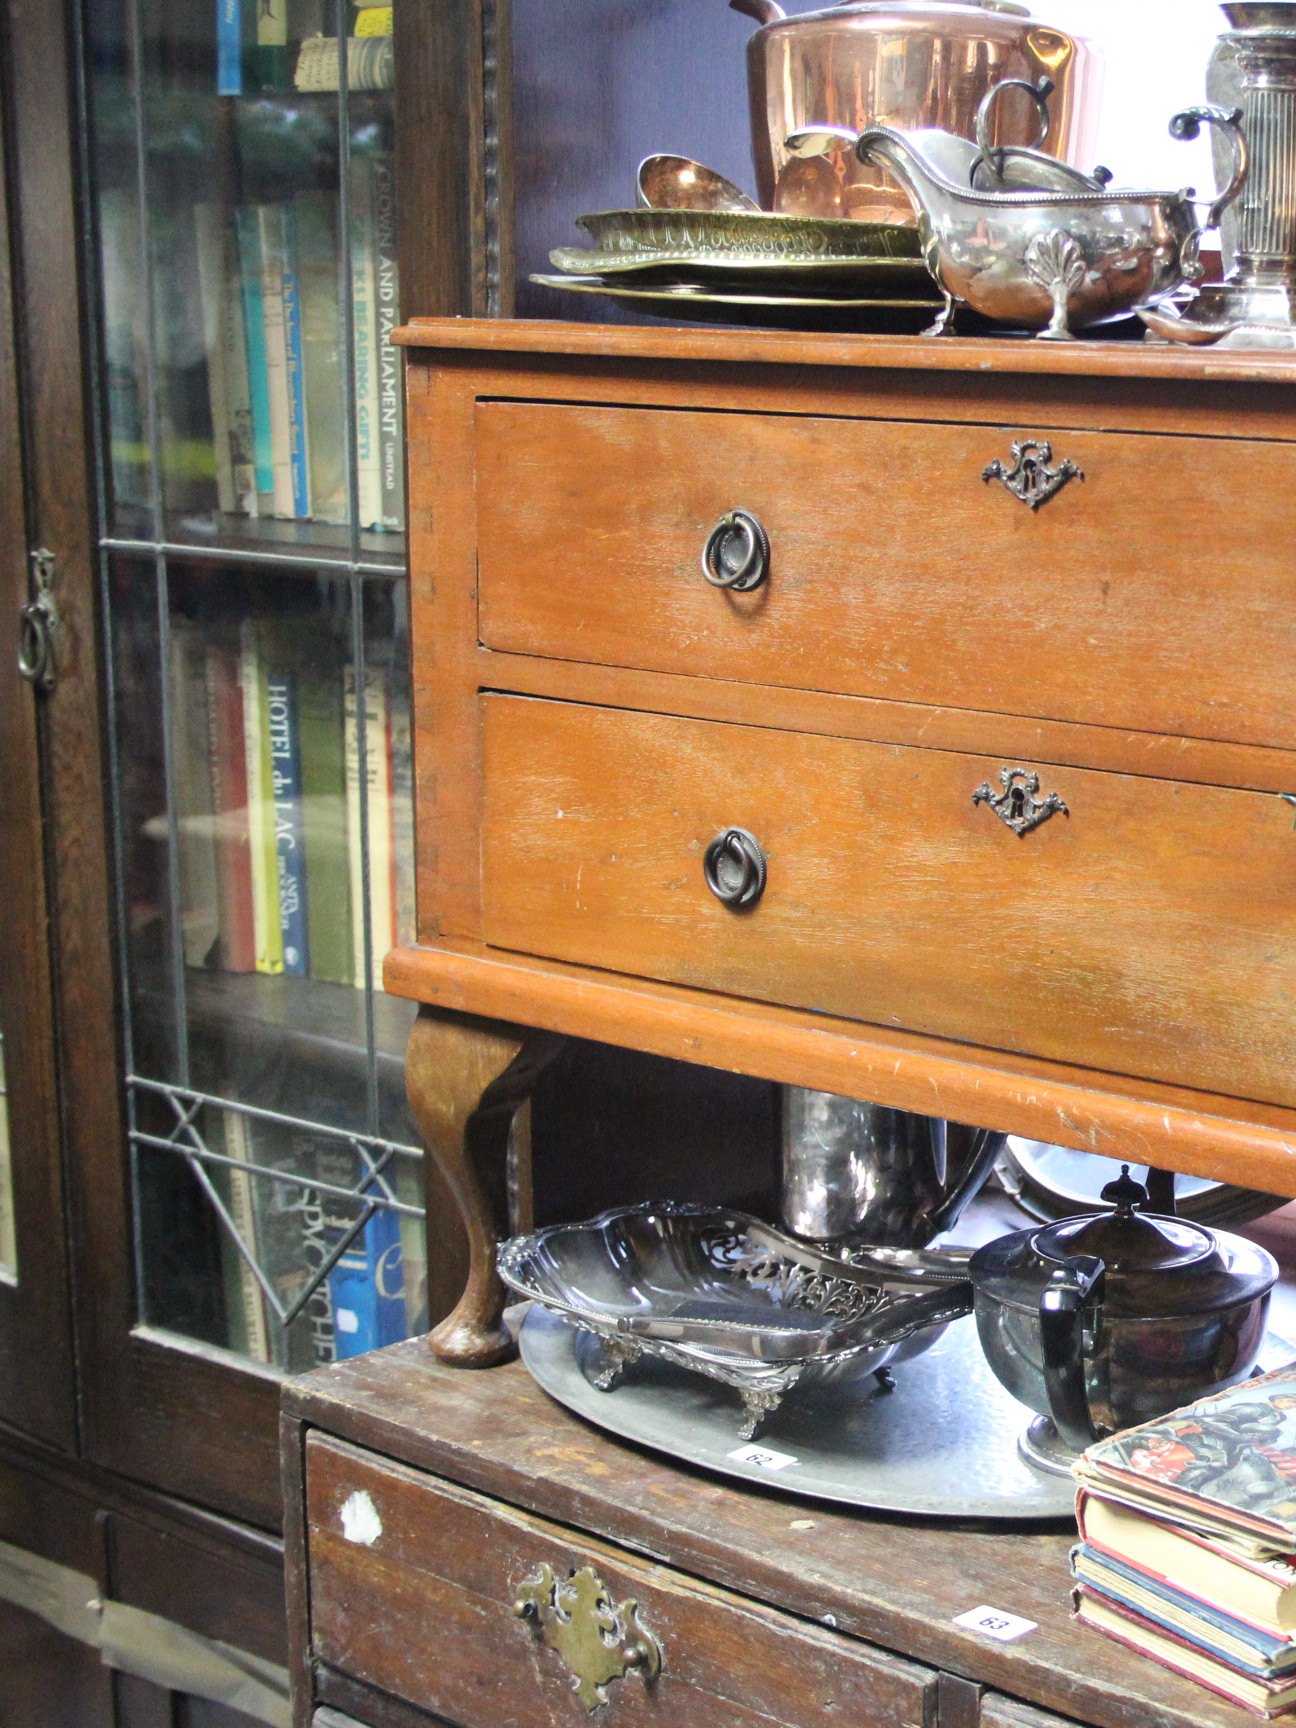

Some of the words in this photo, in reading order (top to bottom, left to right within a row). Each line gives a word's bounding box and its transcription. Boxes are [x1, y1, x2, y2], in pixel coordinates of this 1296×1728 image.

[379, 257, 395, 301] AND
[354, 301, 370, 400] BEARING
[380, 307, 399, 436] PARLIAMENT
[357, 404, 371, 460] GIFTS
[385, 442, 395, 490] UNSTEAD
[268, 684, 290, 761] HOTEL
[272, 767, 293, 795] du
[274, 802, 296, 849] LAC
[301, 1187, 337, 1364] SPYCTCHE
[746, 1453, 773, 1466] 62
[979, 1616, 1010, 1630] 63
